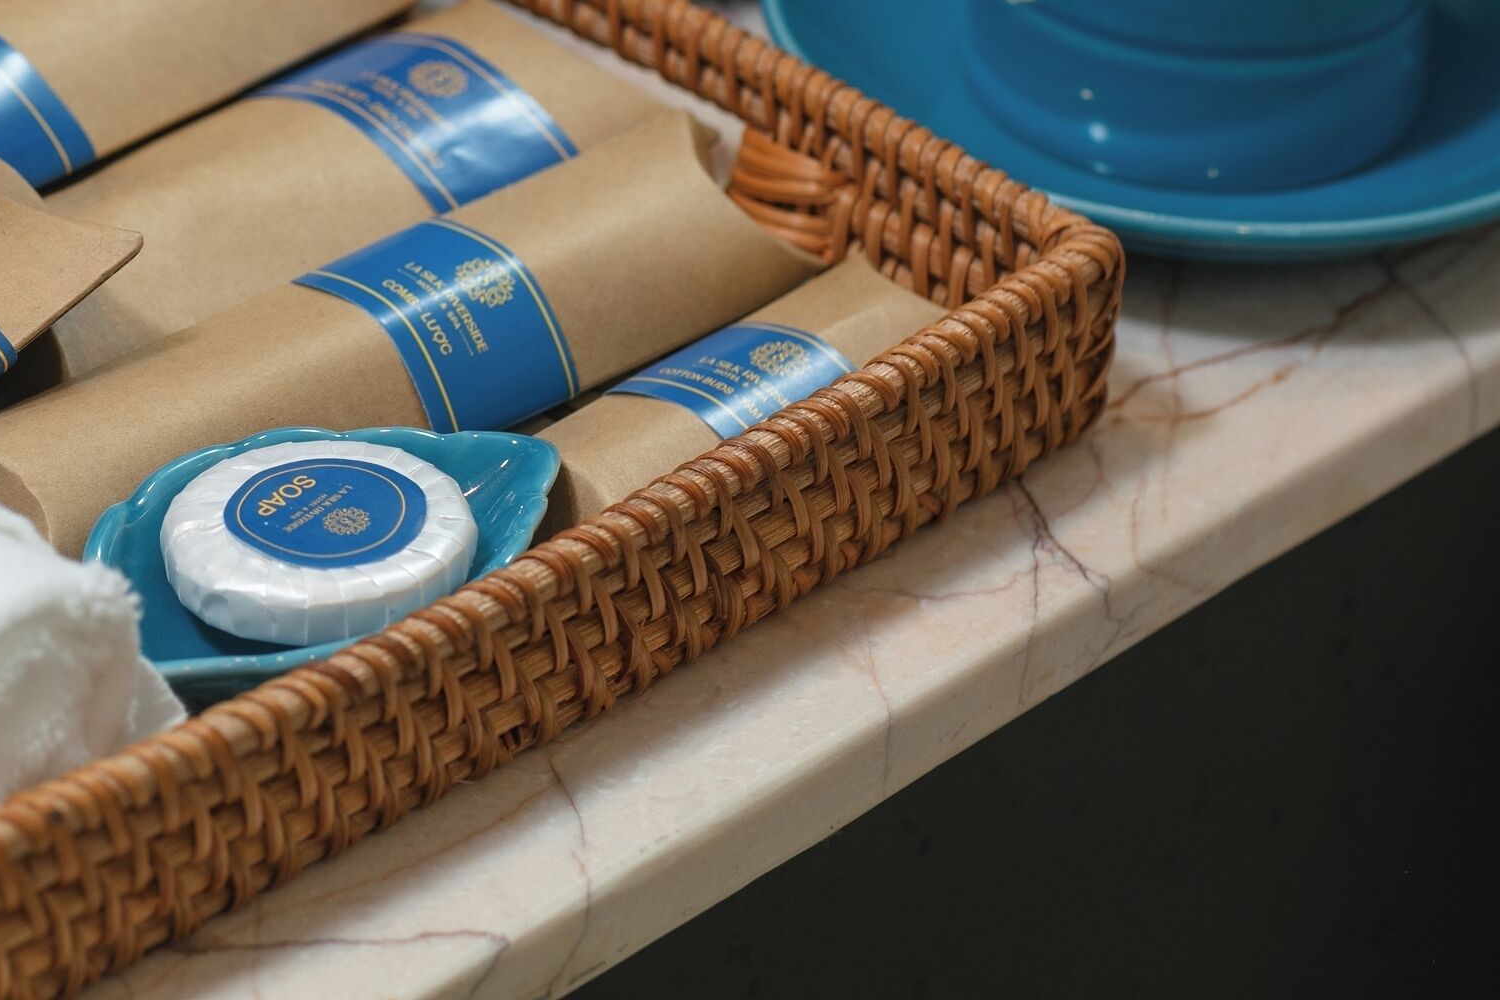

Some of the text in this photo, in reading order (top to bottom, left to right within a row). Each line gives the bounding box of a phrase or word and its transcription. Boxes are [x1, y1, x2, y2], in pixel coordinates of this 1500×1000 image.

[382, 279, 420, 306] COMB
[443, 289, 489, 353] RIVERSIDE
[702, 375, 735, 395] BUDS
[258, 475, 317, 516] SOAP
